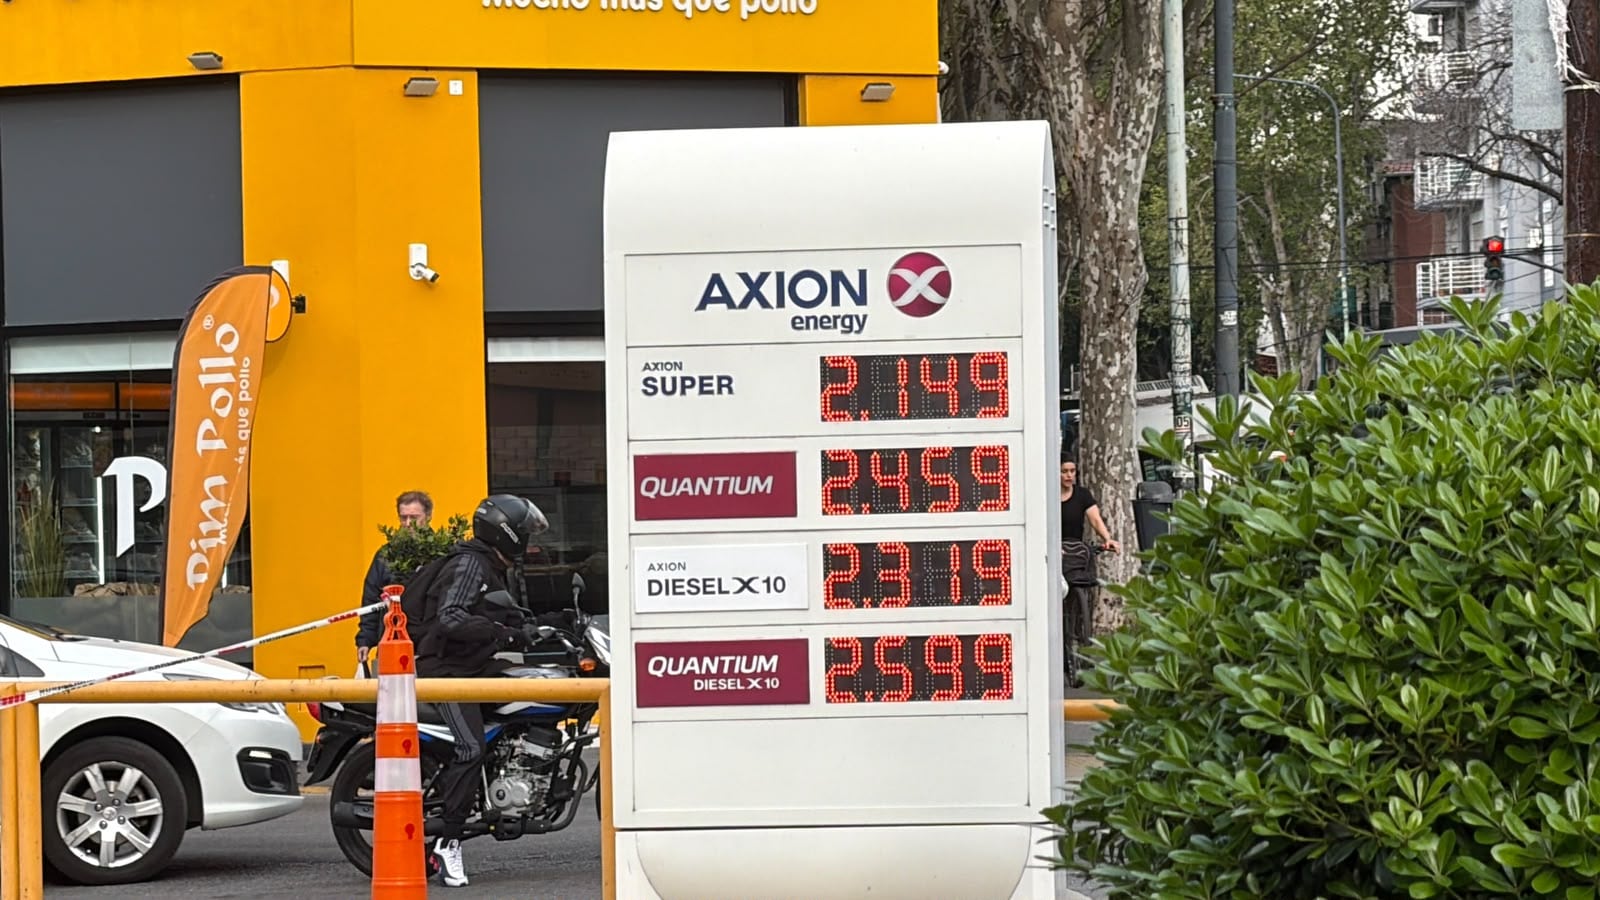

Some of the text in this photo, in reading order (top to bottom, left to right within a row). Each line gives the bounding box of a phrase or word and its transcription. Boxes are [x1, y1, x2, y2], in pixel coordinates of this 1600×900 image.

[694, 268, 868, 312] AXION
[790, 312, 868, 335] energy
[238, 356, 252, 402] pollo
[642, 361, 683, 372] AXION
[642, 374, 735, 397] SUPER
[820, 351, 1009, 422] 2.149
[238, 407, 251, 440] que
[186, 322, 240, 591] Dim Pollo
[640, 475, 773, 499] QUANTIUM
[821, 445, 1010, 516] 2.459
[647, 562, 687, 572] AXION
[823, 539, 1012, 610] 2.319
[647, 654, 779, 678] QUANTIUM
[825, 633, 1013, 704] 2.599
